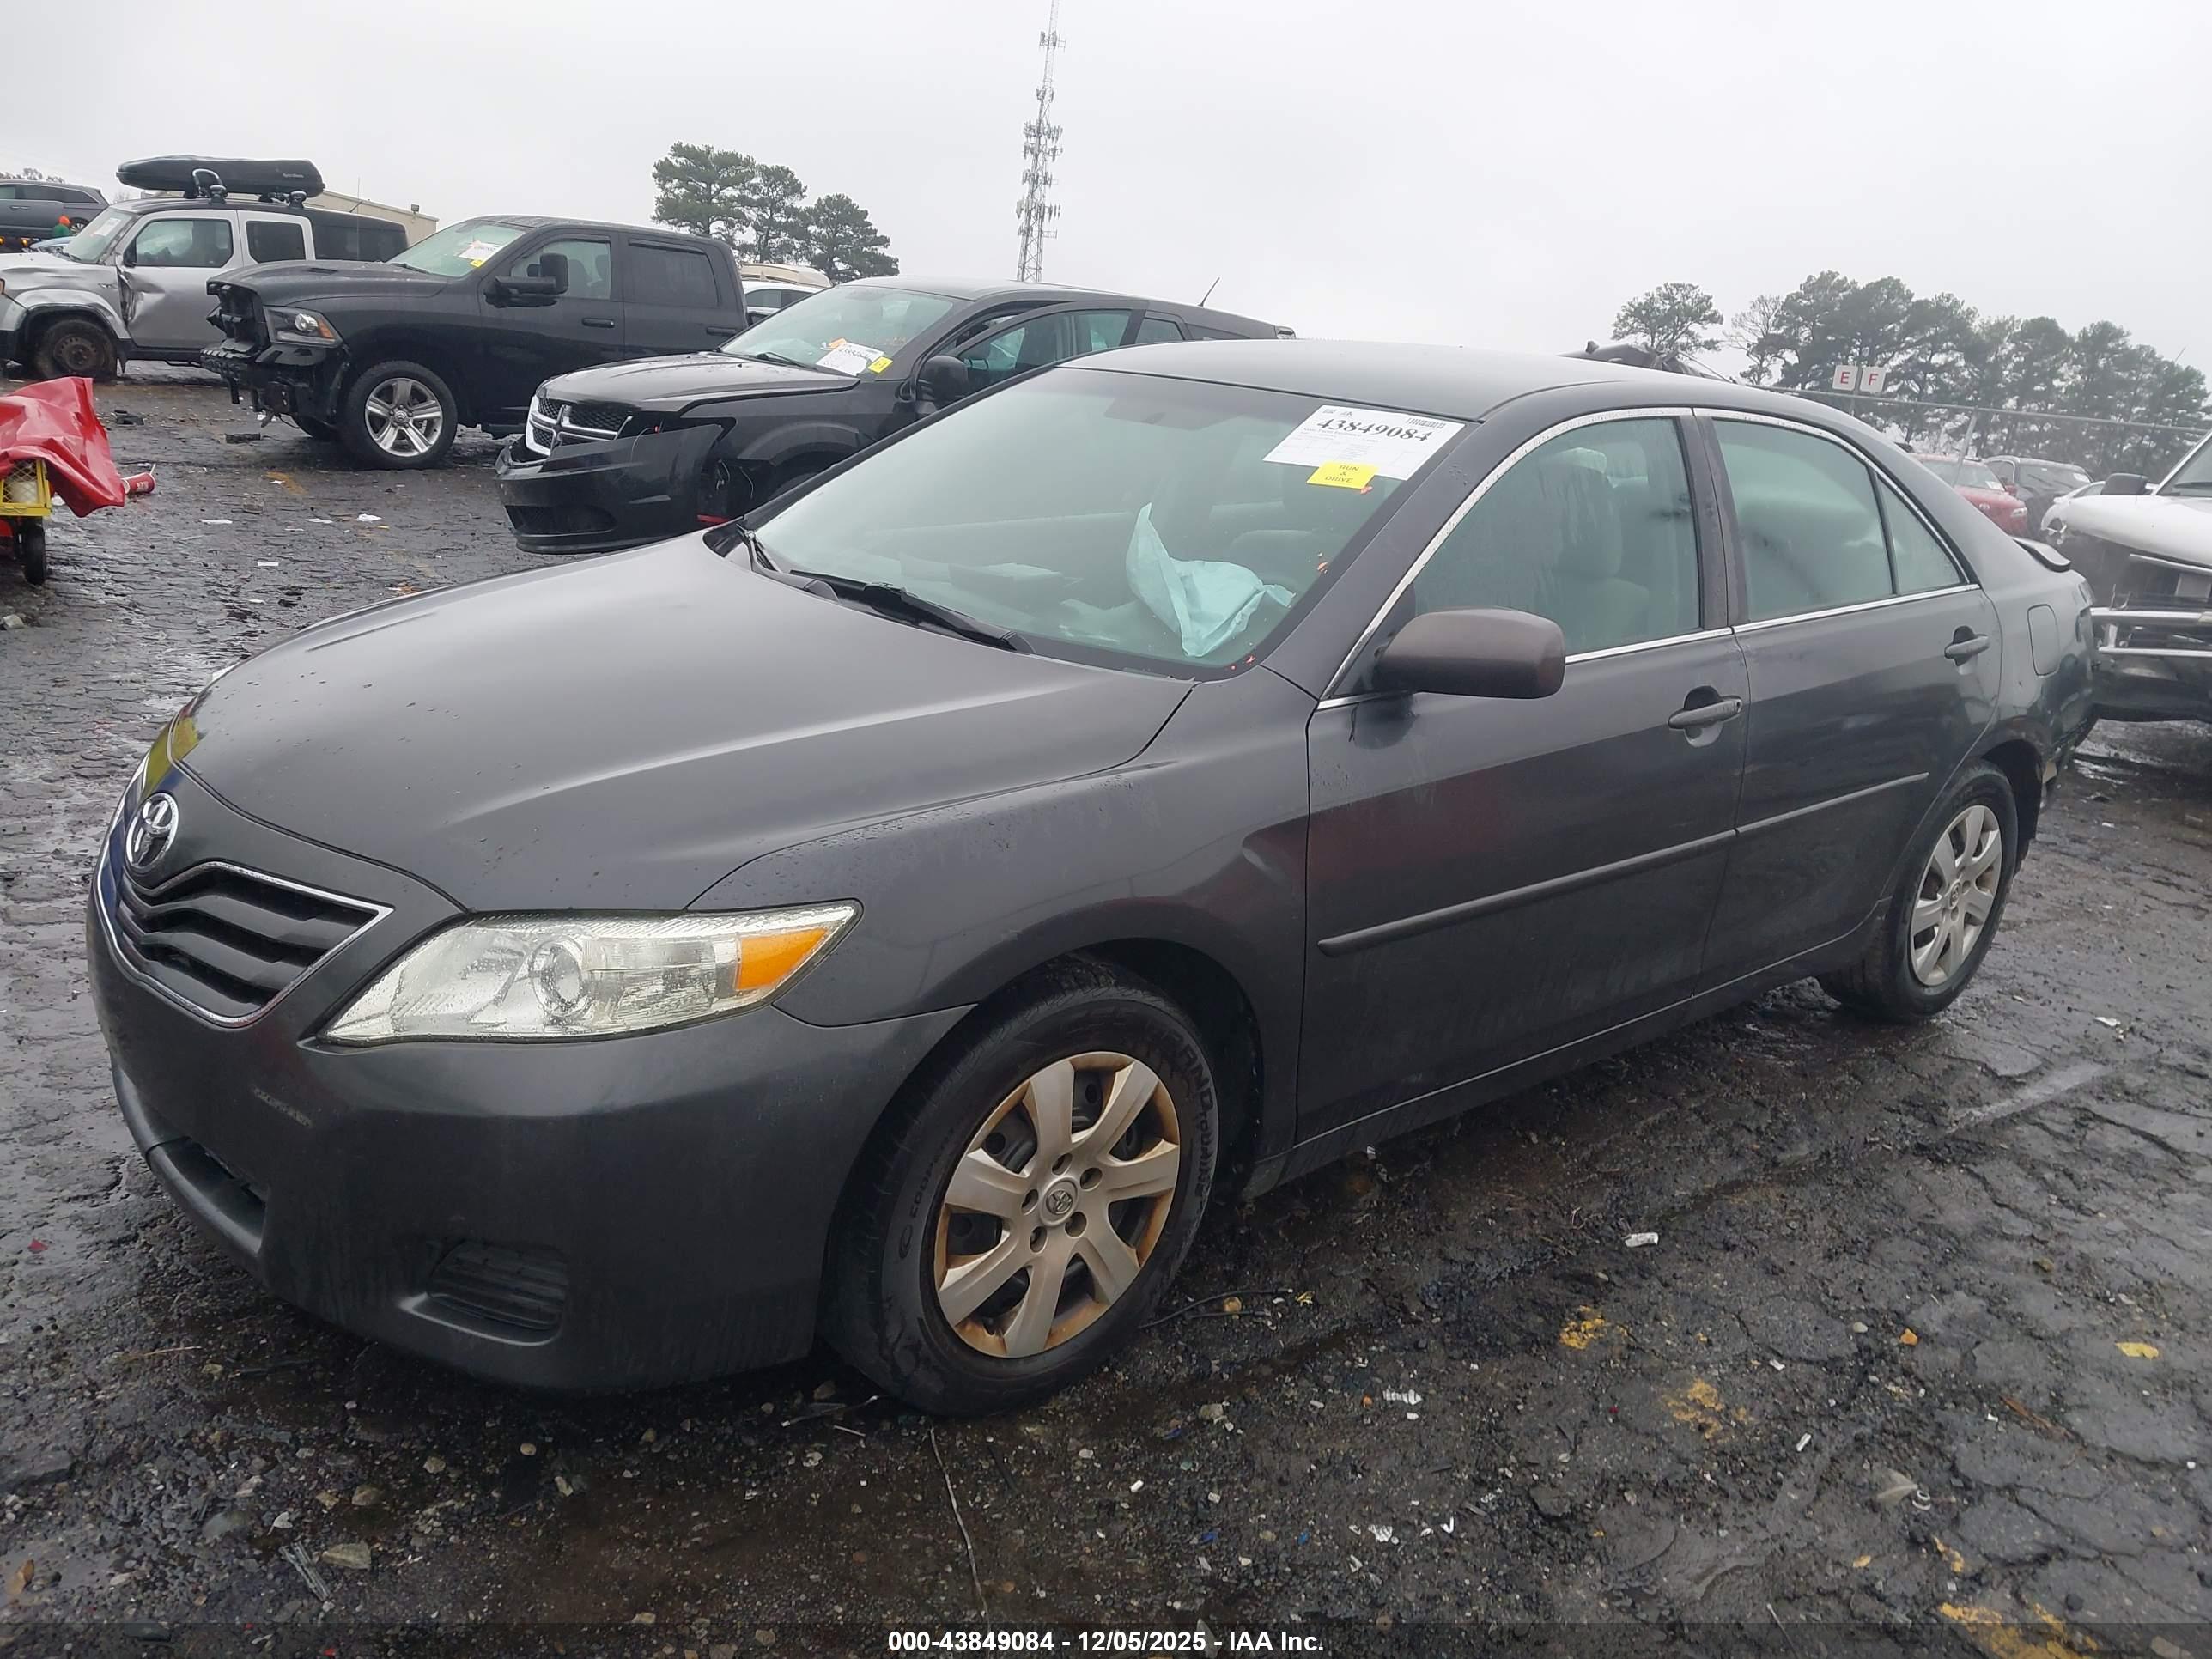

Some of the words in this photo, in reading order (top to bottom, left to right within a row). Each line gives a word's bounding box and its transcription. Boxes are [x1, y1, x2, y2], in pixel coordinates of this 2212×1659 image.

[1840, 372, 1850, 384] E
[1869, 374, 1879, 386] F
[1317, 418, 1432, 441] 43849084
